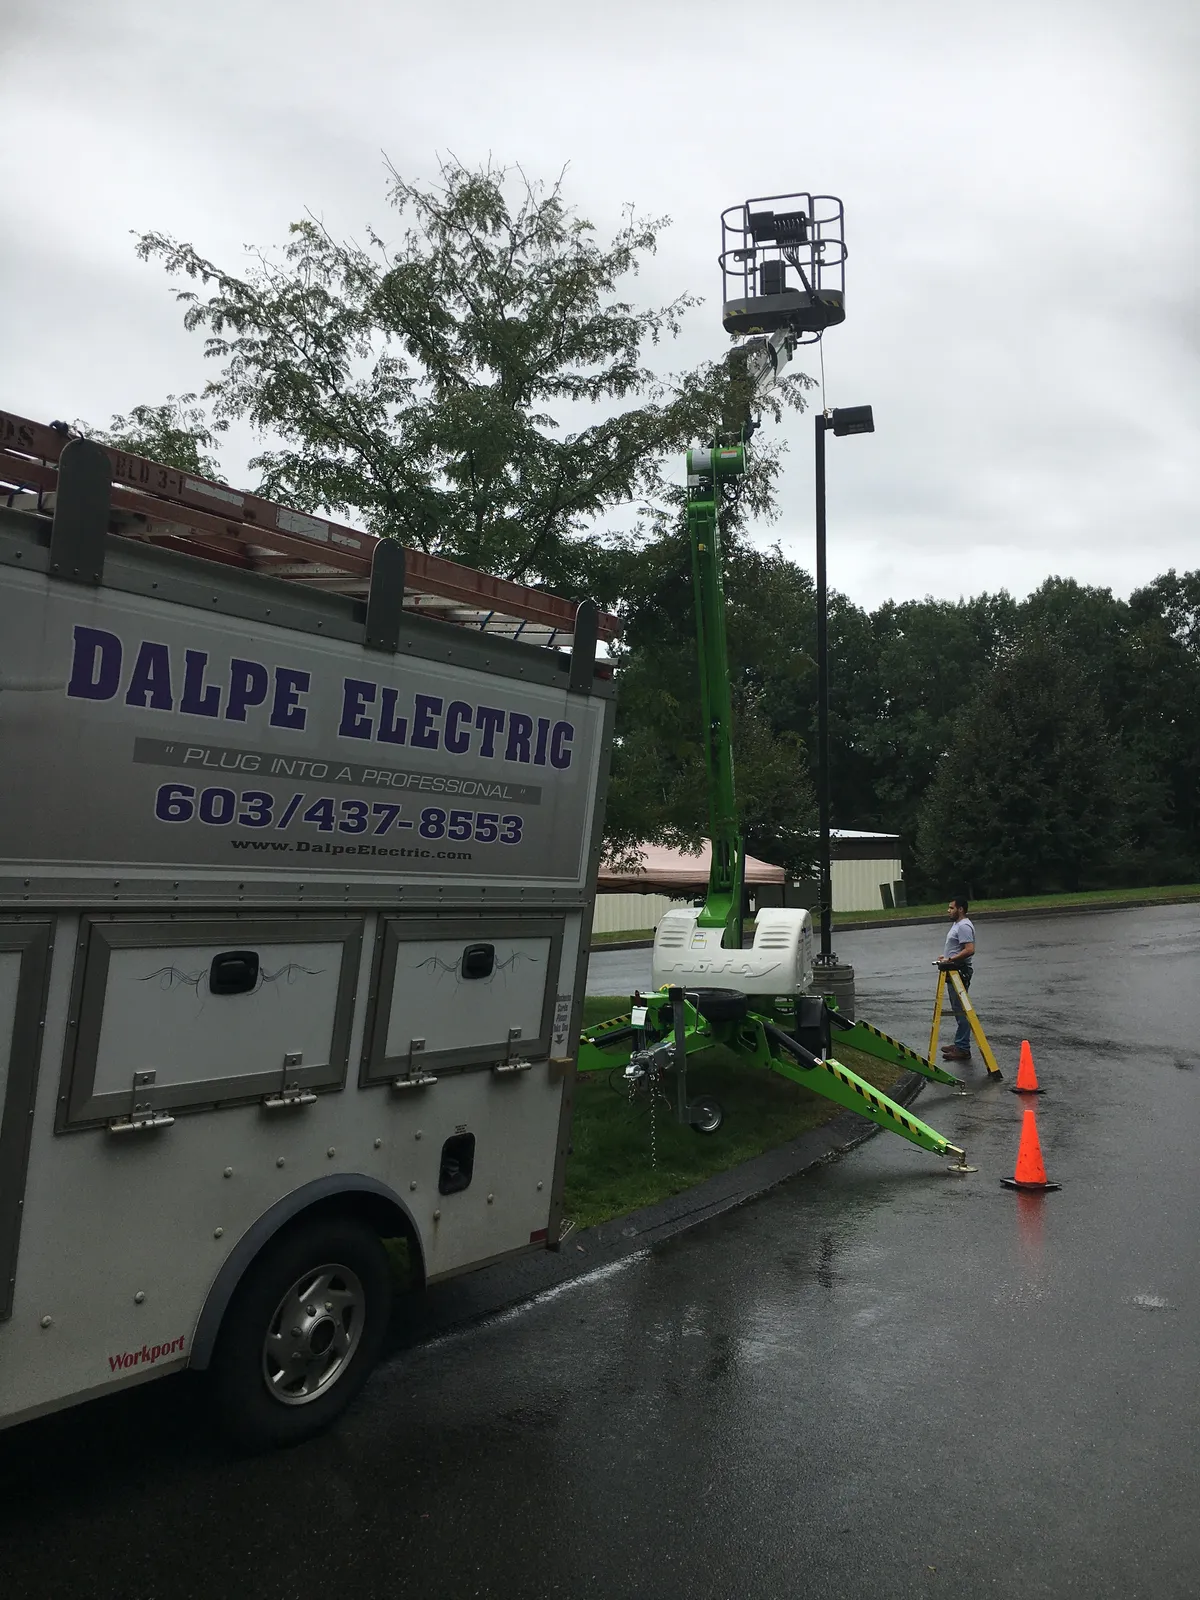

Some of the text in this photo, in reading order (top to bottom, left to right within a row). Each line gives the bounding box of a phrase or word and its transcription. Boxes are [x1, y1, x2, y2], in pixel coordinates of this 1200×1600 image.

[66, 625, 576, 770] DALPE ELECTRIC
[183, 747, 262, 771] PLUG
[270, 758, 329, 779] INTO
[335, 766, 353, 782] A
[361, 769, 513, 799] PROFESSIONAL
[154, 782, 525, 846] 603/437-8553
[230, 840, 473, 861] www.DalpeElectric.com
[108, 1334, 186, 1373] Workport
